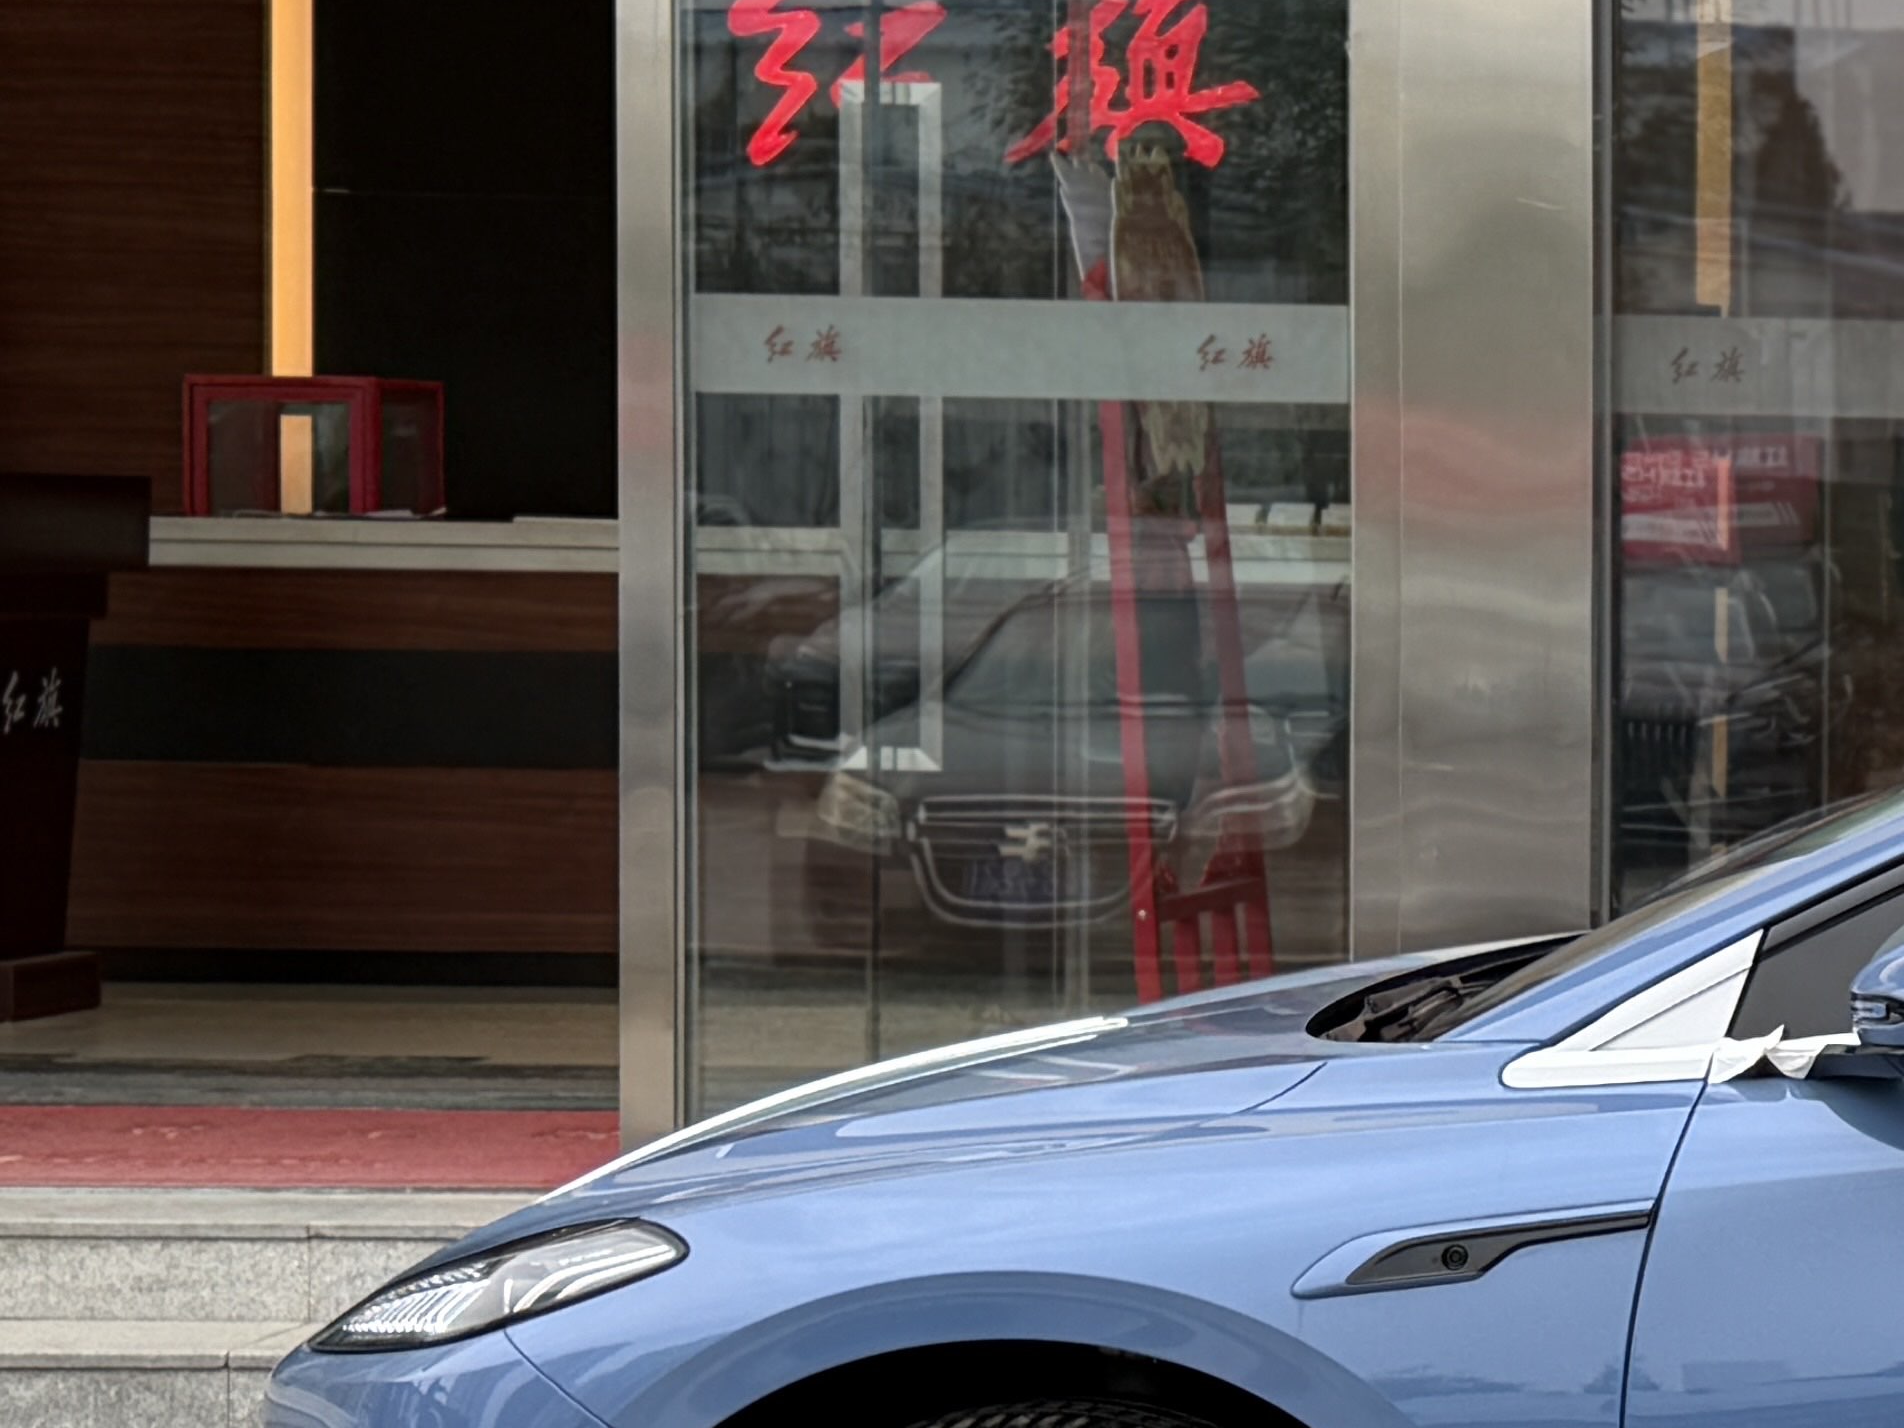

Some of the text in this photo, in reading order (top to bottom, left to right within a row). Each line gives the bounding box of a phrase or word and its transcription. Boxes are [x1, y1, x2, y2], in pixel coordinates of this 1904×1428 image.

[763, 324, 843, 364] 红旗
[1197, 333, 1276, 374] 红旗
[1670, 347, 1745, 384] 红旗
[2, 666, 63, 734] 红旗
